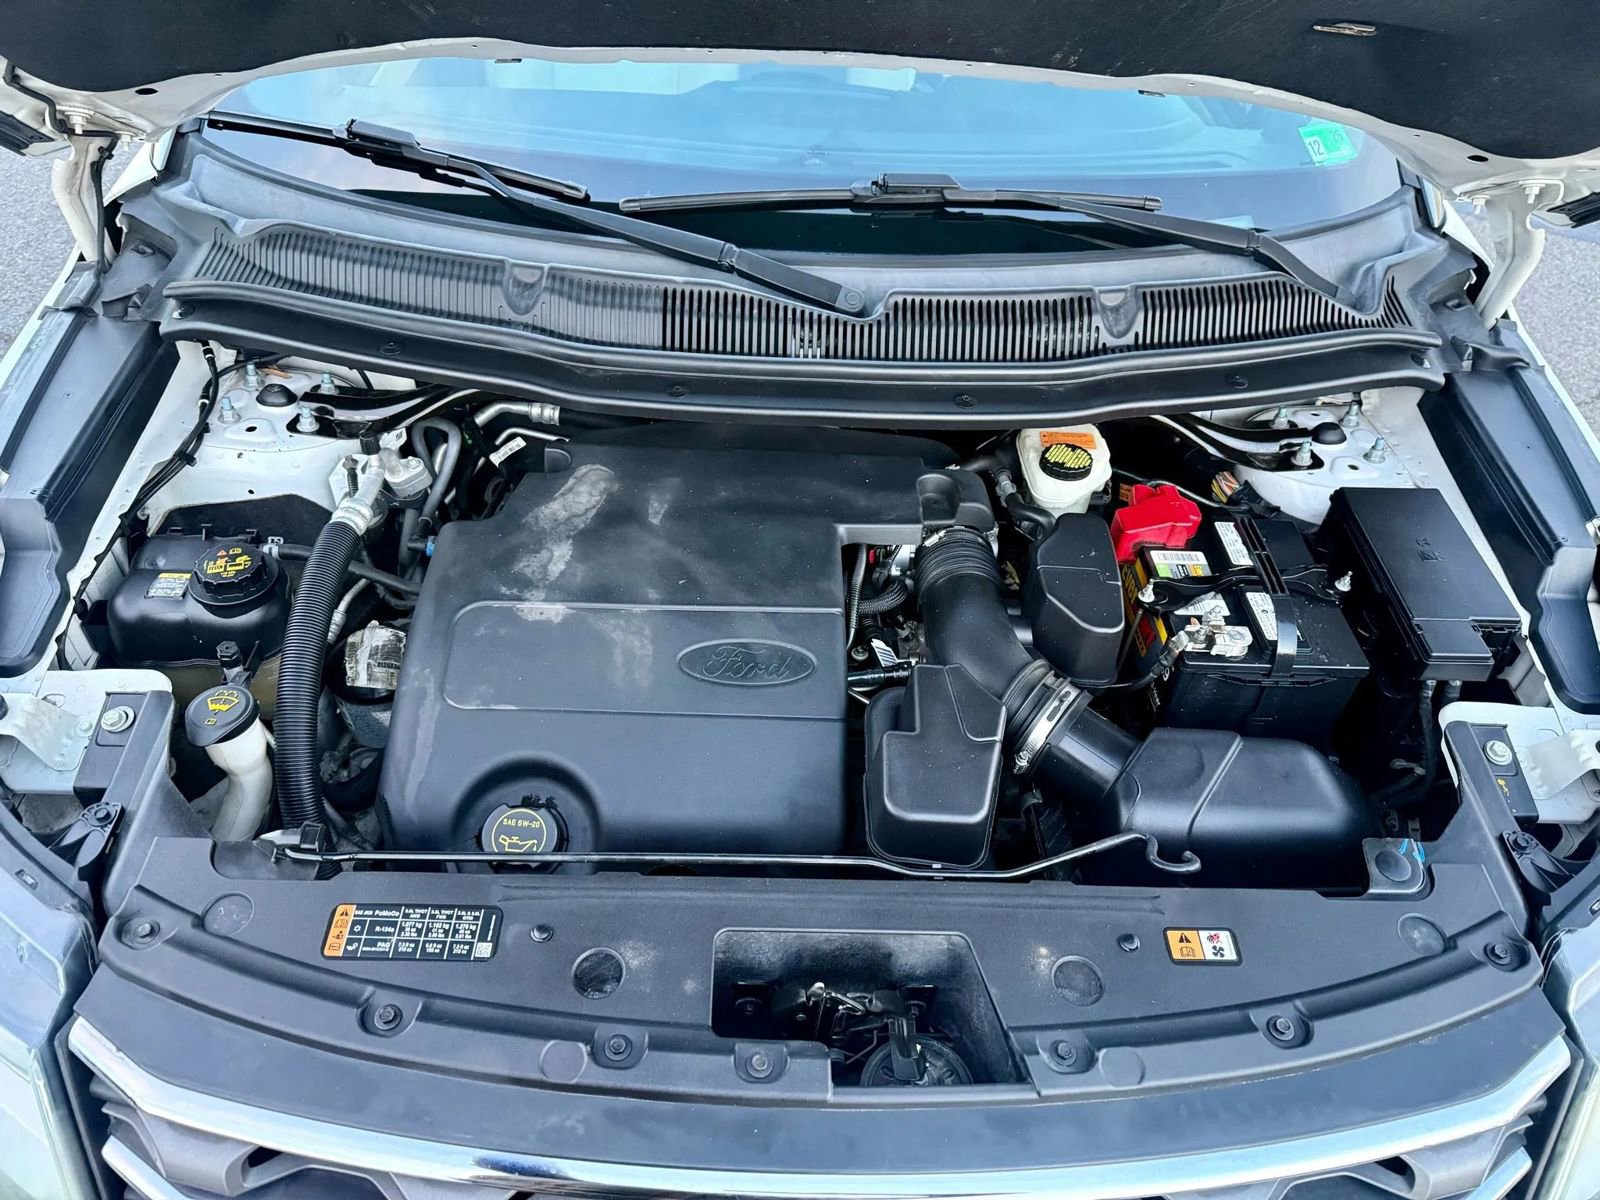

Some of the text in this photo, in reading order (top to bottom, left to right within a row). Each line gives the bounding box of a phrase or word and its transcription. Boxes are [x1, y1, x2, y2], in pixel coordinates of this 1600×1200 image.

[1307, 139, 1325, 157] 12
[702, 645, 792, 679] Ford
[503, 818, 516, 826] SAE
